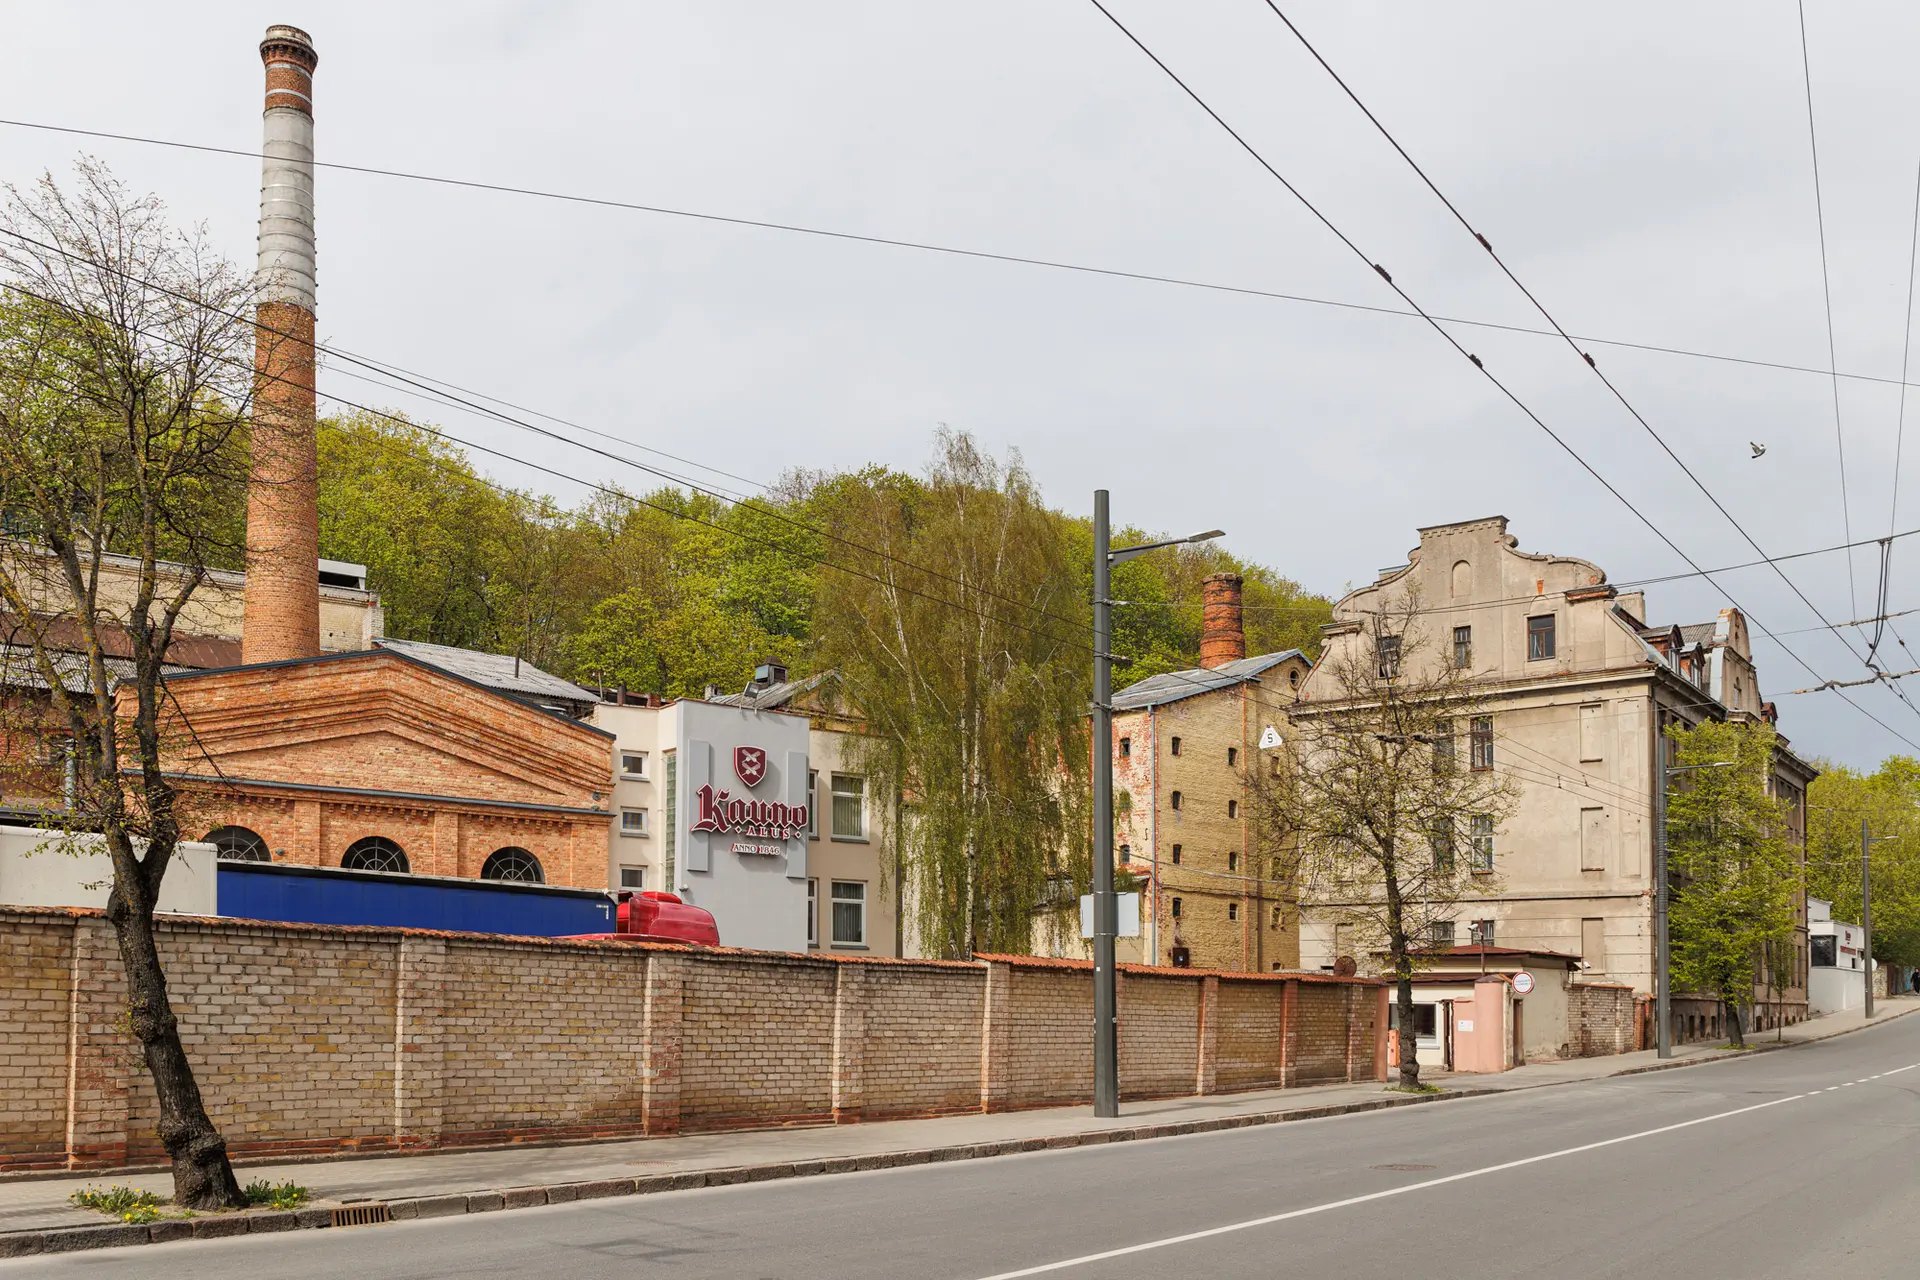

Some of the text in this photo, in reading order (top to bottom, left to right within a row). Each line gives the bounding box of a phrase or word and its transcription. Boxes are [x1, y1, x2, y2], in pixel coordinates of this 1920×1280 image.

[690, 783, 808, 833] Kauno
[745, 825, 791, 841] ALUS
[732, 843, 780, 856] ANNO 1846
